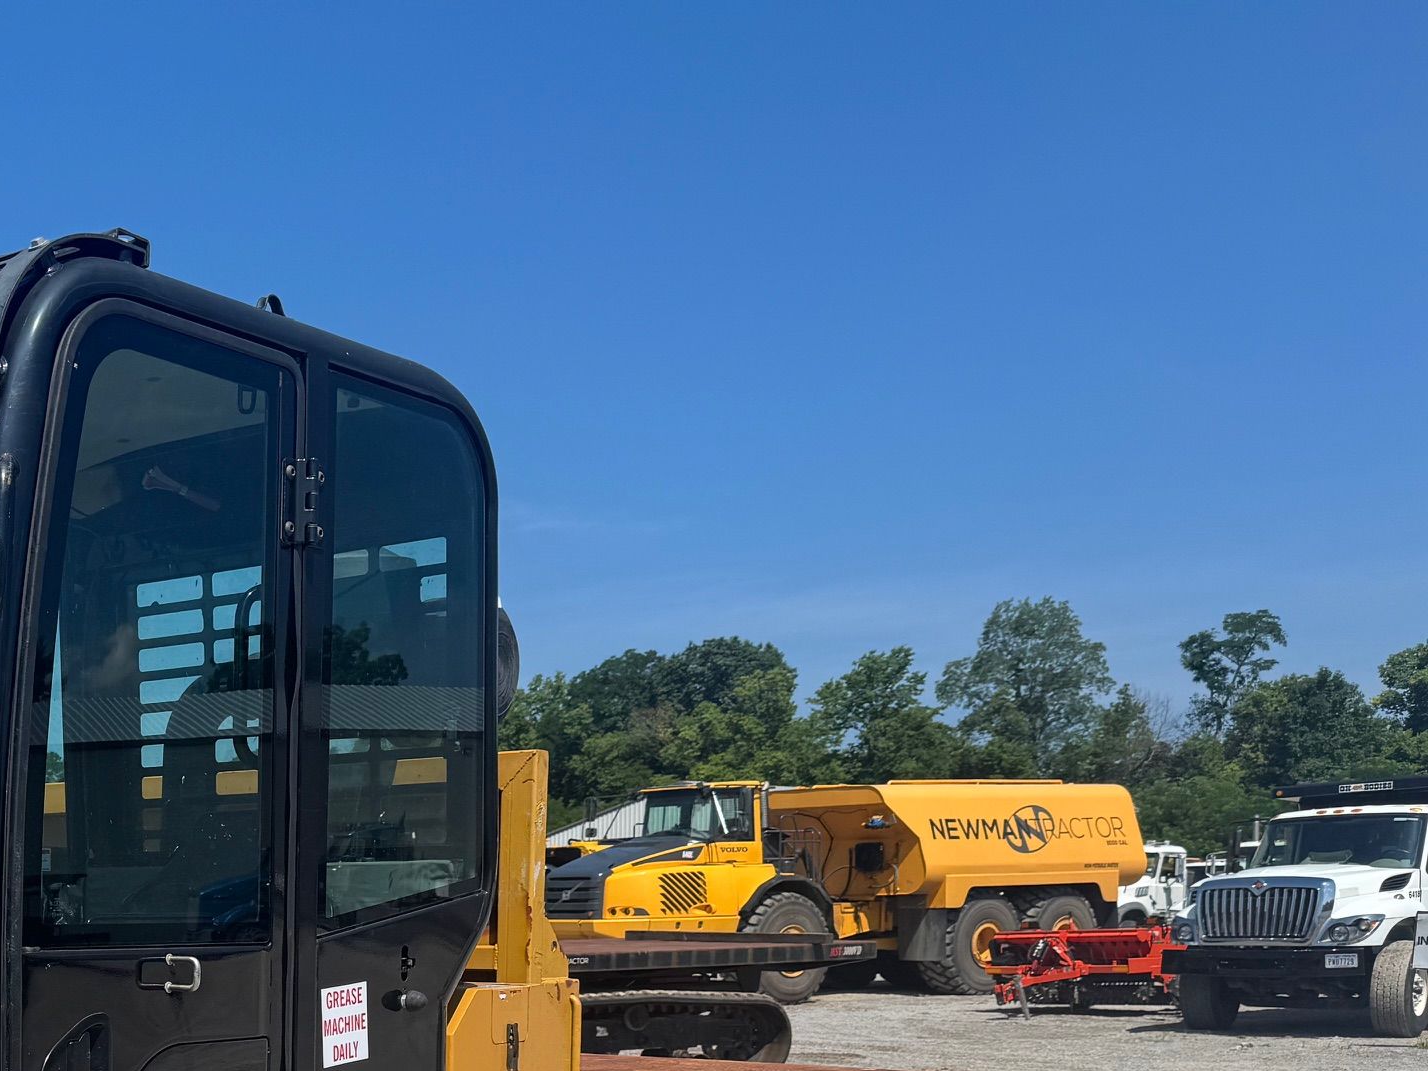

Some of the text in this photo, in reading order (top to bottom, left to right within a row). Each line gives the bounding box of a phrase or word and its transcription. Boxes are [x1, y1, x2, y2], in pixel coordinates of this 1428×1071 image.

[568, 957, 589, 965] ACTOR
[326, 987, 363, 1009] GREASE
[323, 1013, 366, 1037] MACHINE
[333, 1041, 359, 1062] DAILY
